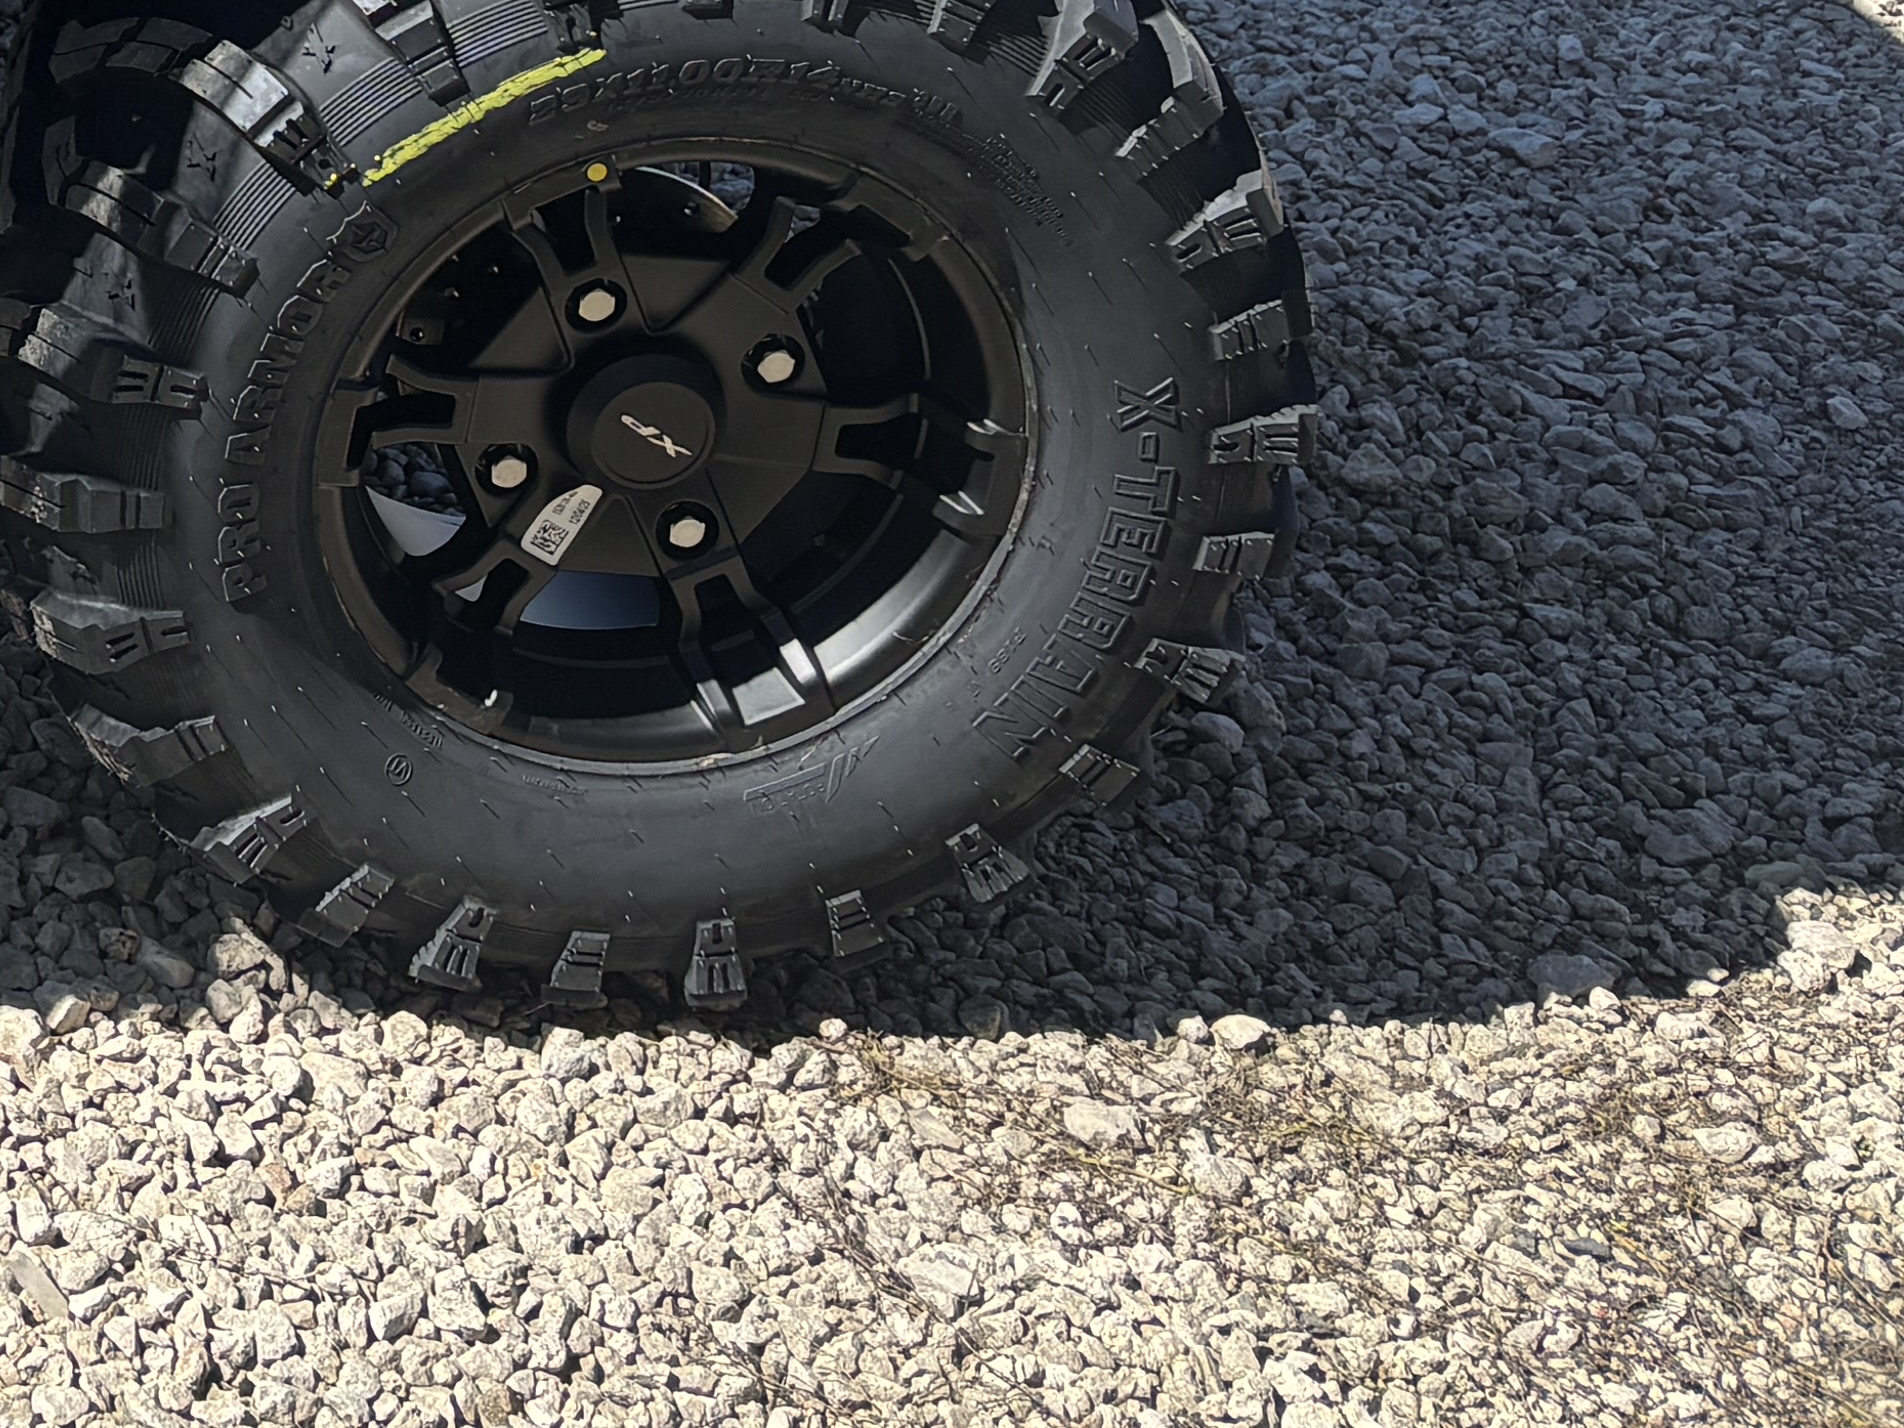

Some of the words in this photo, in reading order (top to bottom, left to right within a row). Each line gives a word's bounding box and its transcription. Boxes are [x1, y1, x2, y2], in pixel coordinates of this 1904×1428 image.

[225, 257, 352, 467] ARMOR
[621, 414, 692, 458] XP
[217, 482, 268, 602] PRO
[973, 376, 1180, 756] X-TERRAIN
